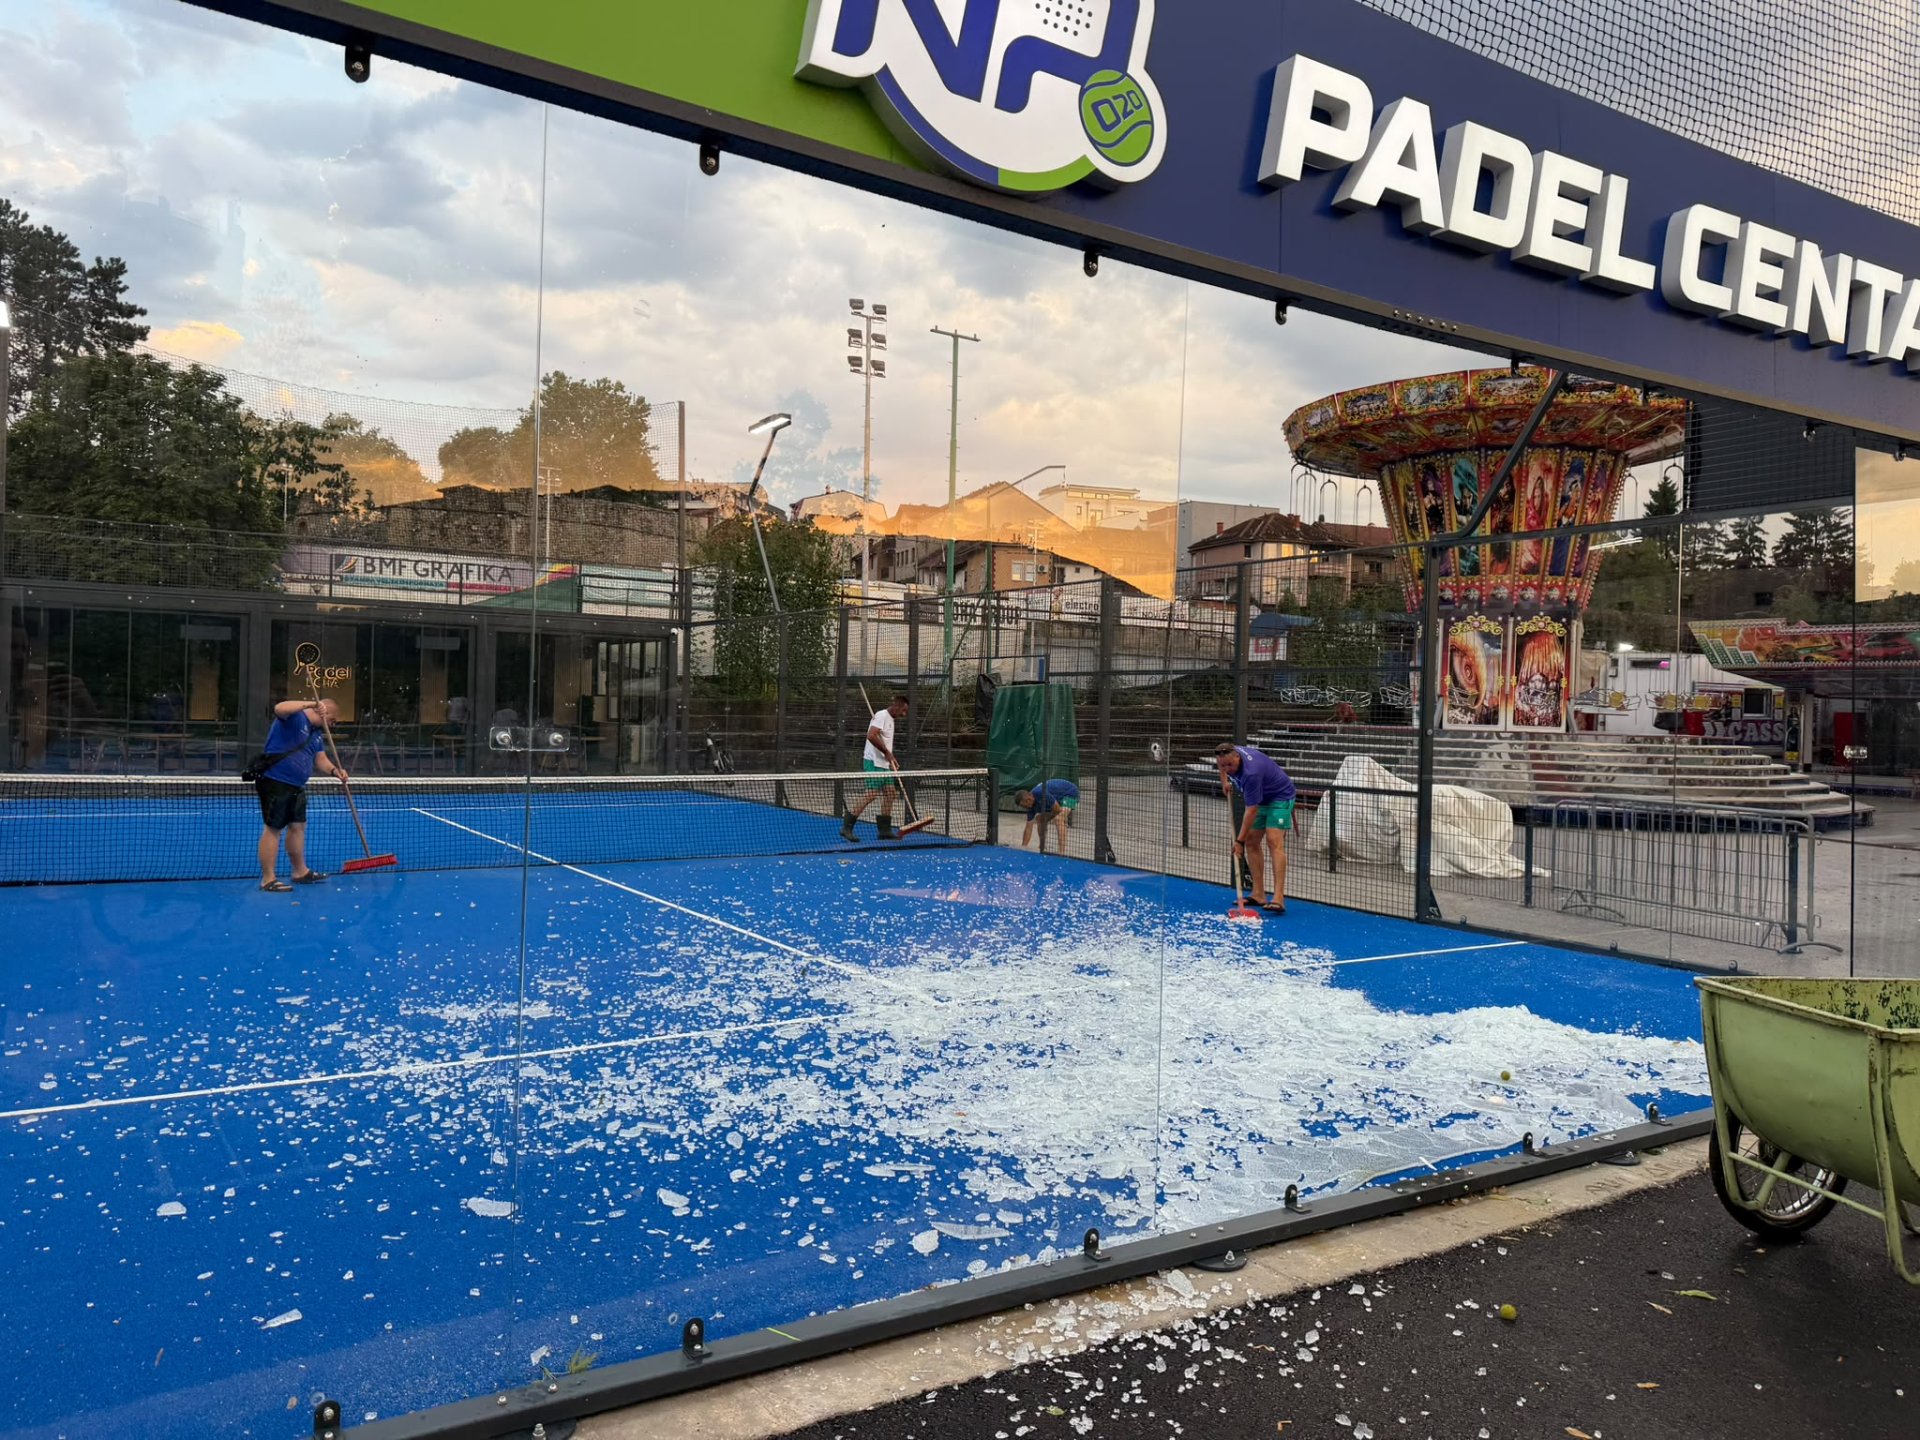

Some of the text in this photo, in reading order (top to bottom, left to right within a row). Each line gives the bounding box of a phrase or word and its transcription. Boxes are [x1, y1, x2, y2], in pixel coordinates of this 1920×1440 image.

[1091, 90, 1143, 132] 020
[1258, 54, 1656, 294] PADEL
[363, 556, 513, 582] BMF GRAFIKA
[1065, 599, 1099, 611] electro
[306, 664, 352, 680] Padel
